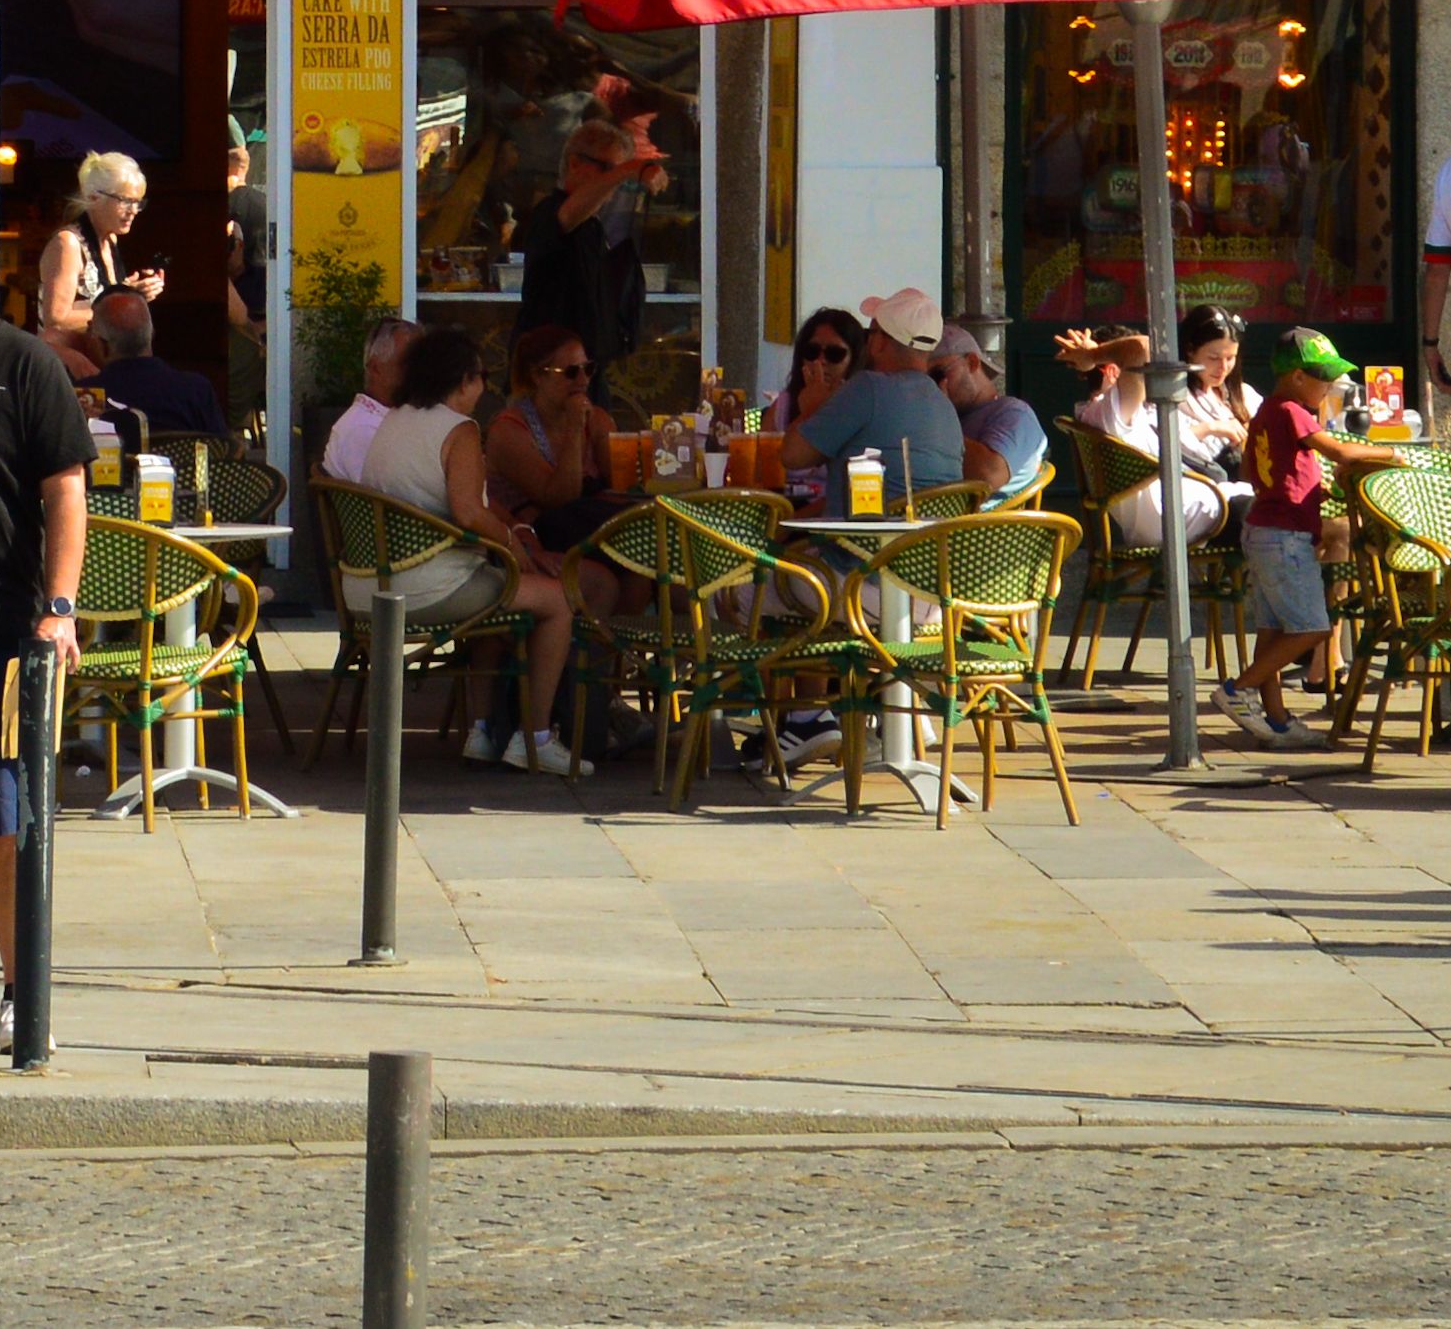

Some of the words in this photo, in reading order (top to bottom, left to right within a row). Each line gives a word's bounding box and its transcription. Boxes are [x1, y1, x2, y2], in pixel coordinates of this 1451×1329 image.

[302, 15, 360, 44] SERRA
[368, 15, 390, 44] DA
[302, 47, 360, 69] ESTRELA
[365, 47, 392, 69] PDO
[301, 72, 344, 91] CHEESE
[347, 72, 392, 91] FILLING
